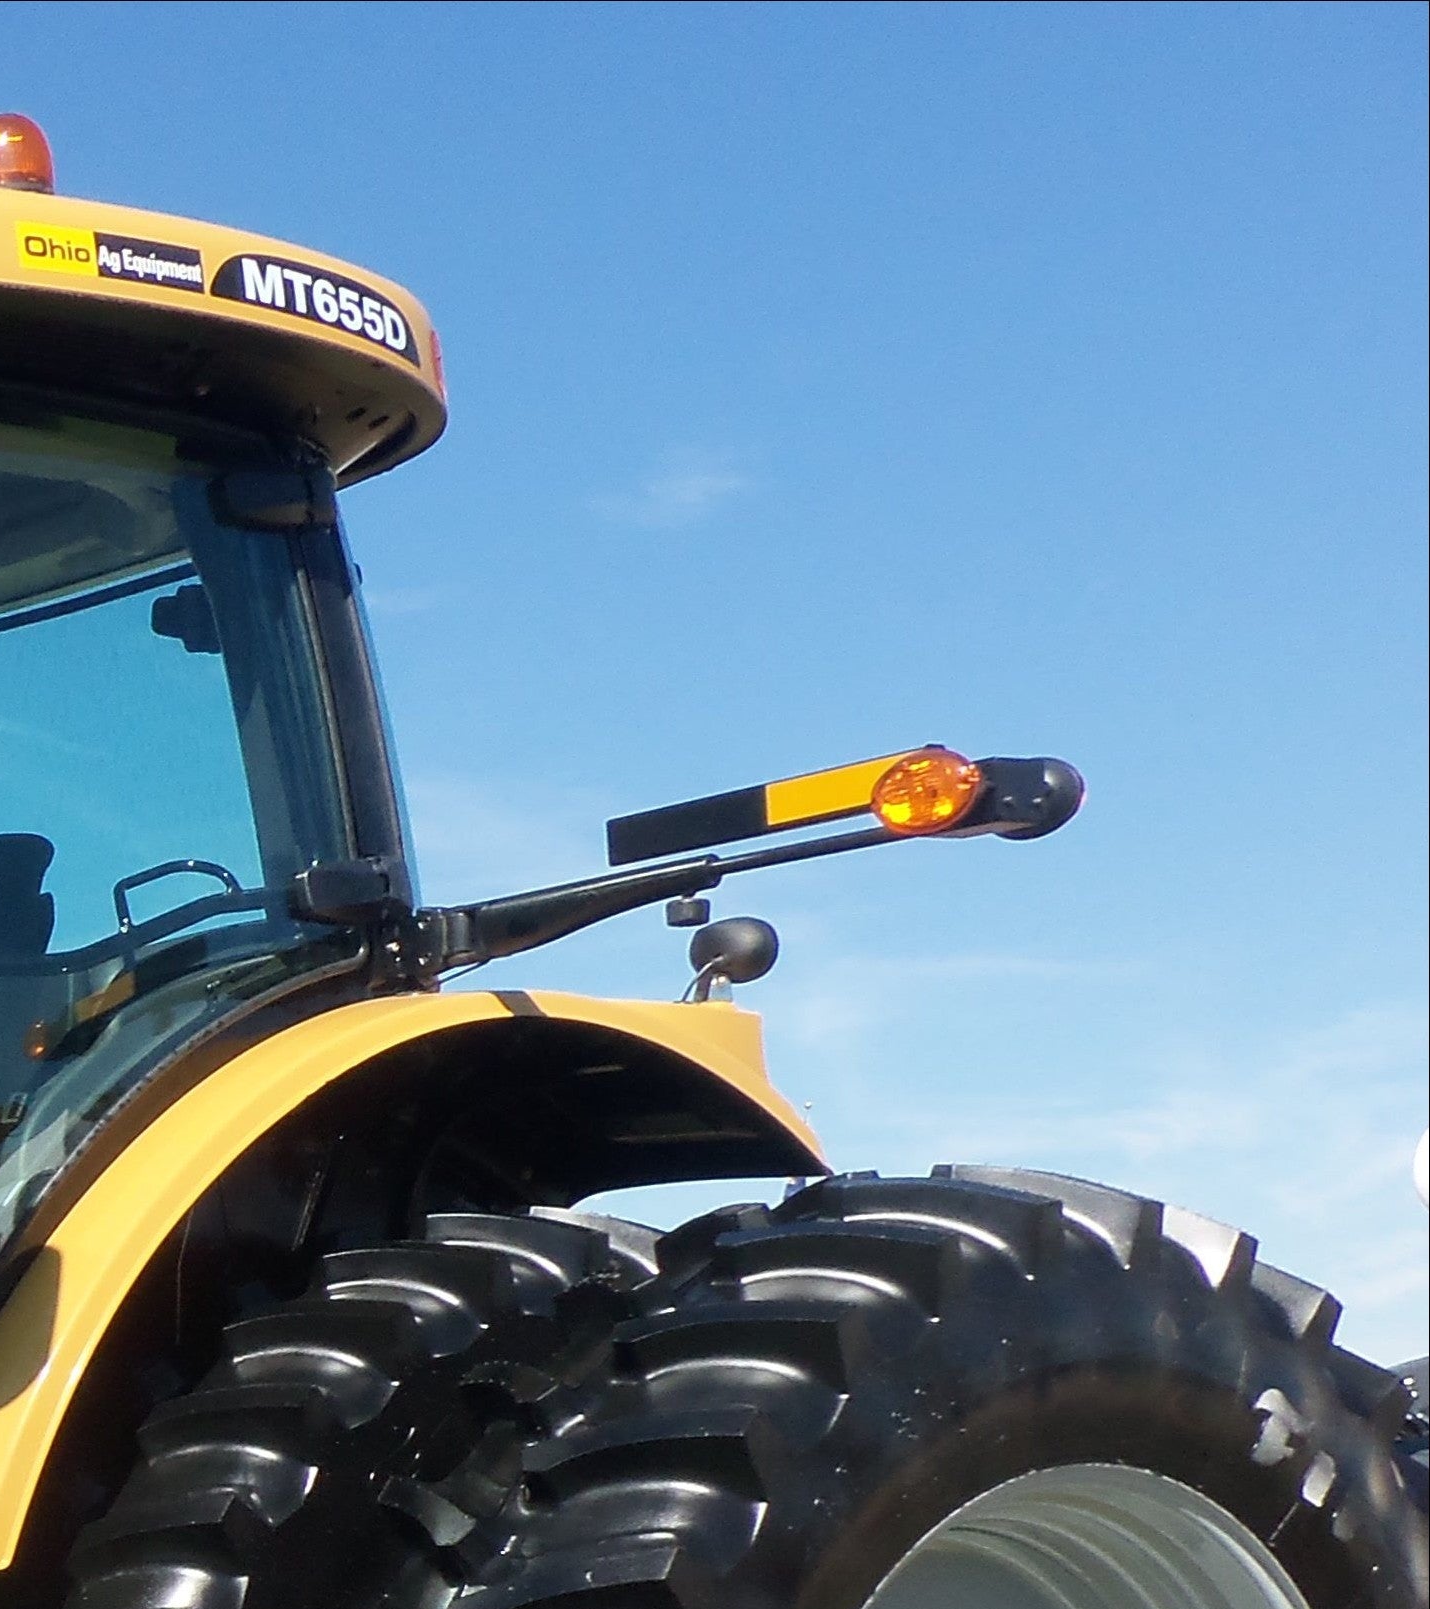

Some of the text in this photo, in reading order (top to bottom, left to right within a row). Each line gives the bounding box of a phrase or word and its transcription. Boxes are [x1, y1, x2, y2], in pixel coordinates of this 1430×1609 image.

[24, 235, 203, 284] Ohio Ag Equipment
[241, 257, 408, 352] MT655D
